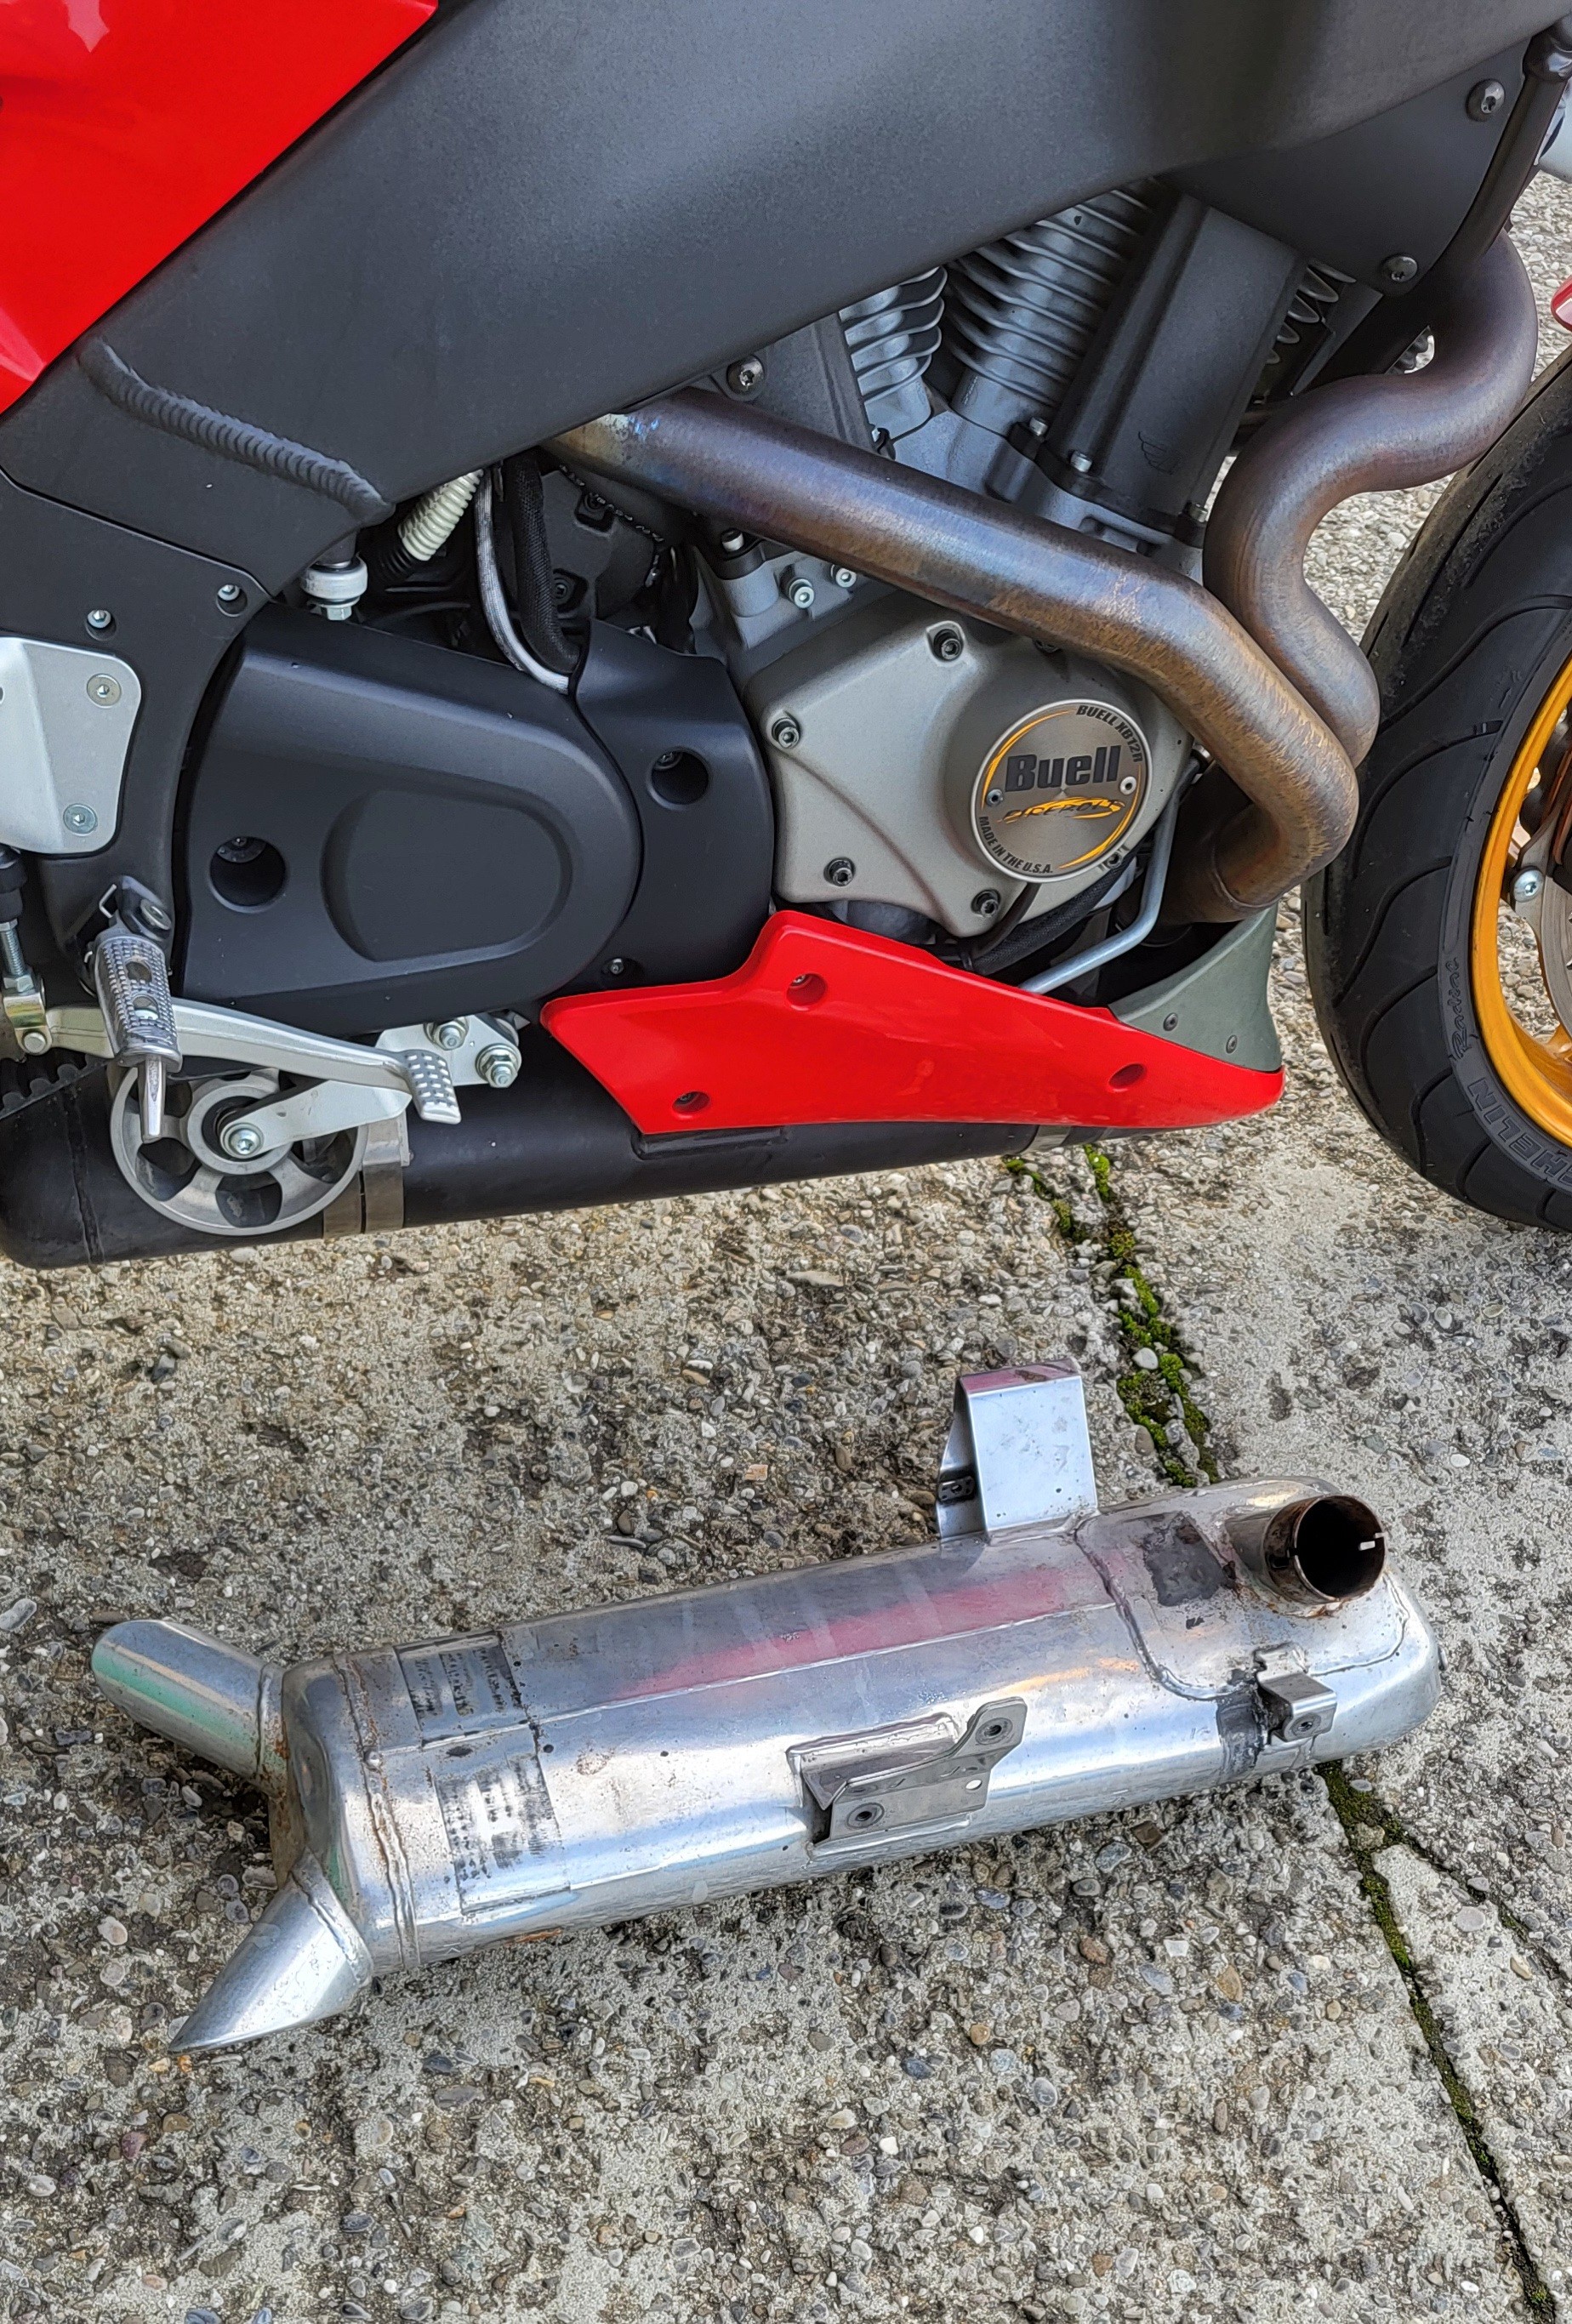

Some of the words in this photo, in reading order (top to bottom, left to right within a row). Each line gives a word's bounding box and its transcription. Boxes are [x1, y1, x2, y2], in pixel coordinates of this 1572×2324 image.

[1076, 704, 1119, 726] BUELL
[1114, 721, 1143, 763] XB12R
[1005, 744, 1122, 793] Buell
[978, 816, 998, 846] MADE
[992, 844, 1006, 857] IN
[1002, 852, 1024, 869] THE
[1022, 862, 1054, 874] U.S.A.
